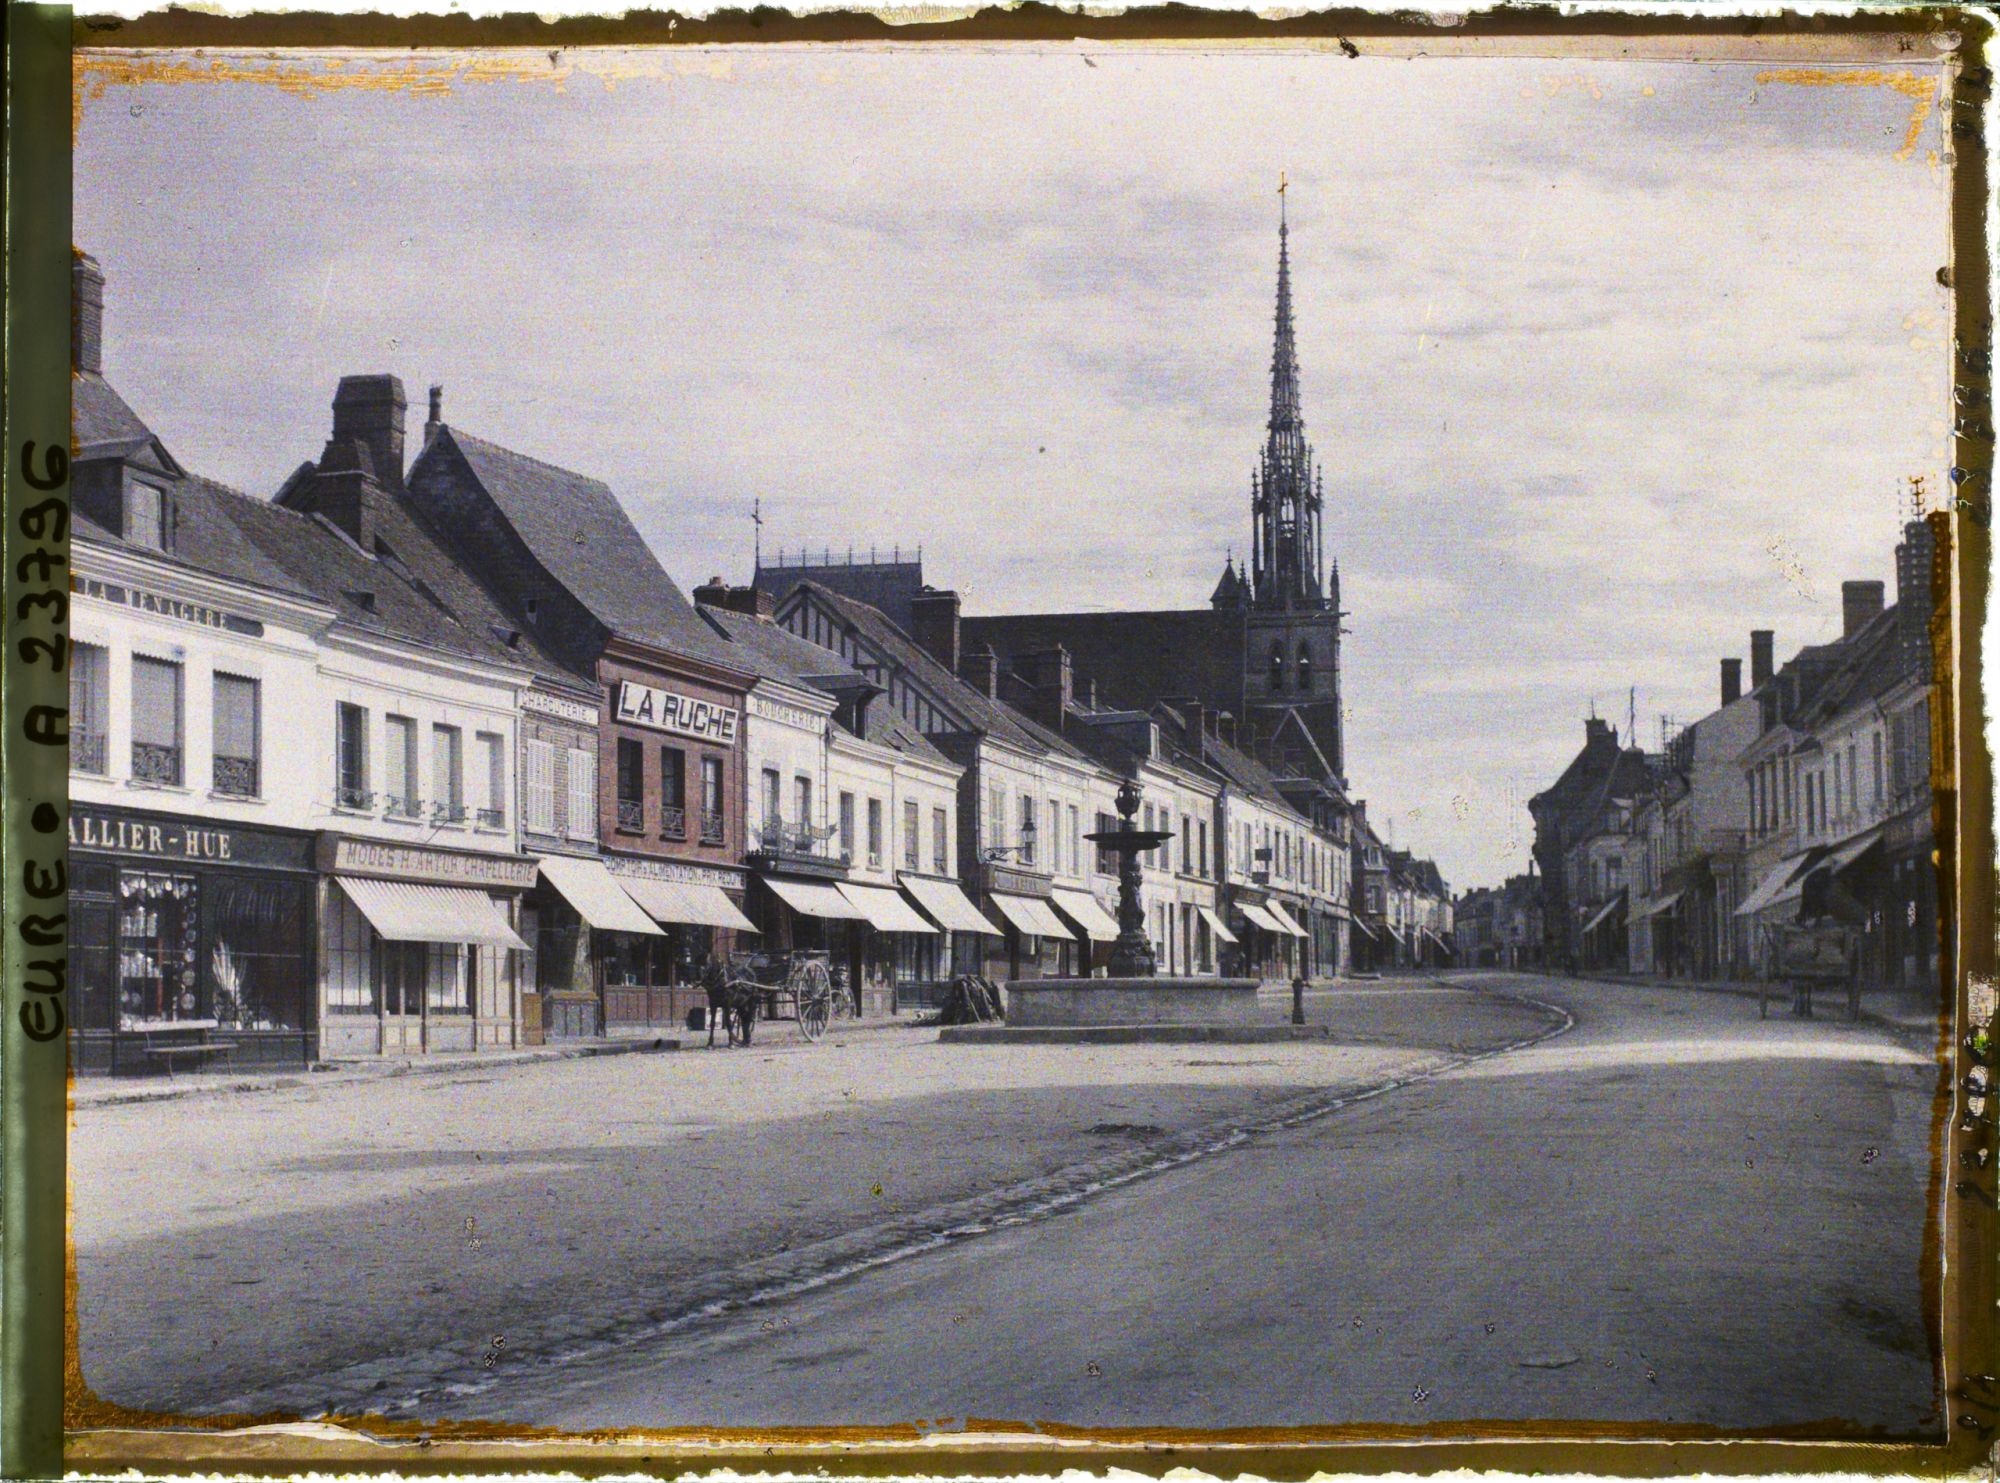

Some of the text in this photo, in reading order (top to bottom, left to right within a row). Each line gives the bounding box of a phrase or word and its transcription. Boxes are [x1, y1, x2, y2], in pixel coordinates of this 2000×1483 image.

[84, 578, 106, 600] LA
[620, 683, 737, 741] LA RUCHE
[16, 440, 69, 1042] EURE A 23796
[346, 842, 394, 868] MODES
[464, 856, 534, 883] CHAPELLERIE
